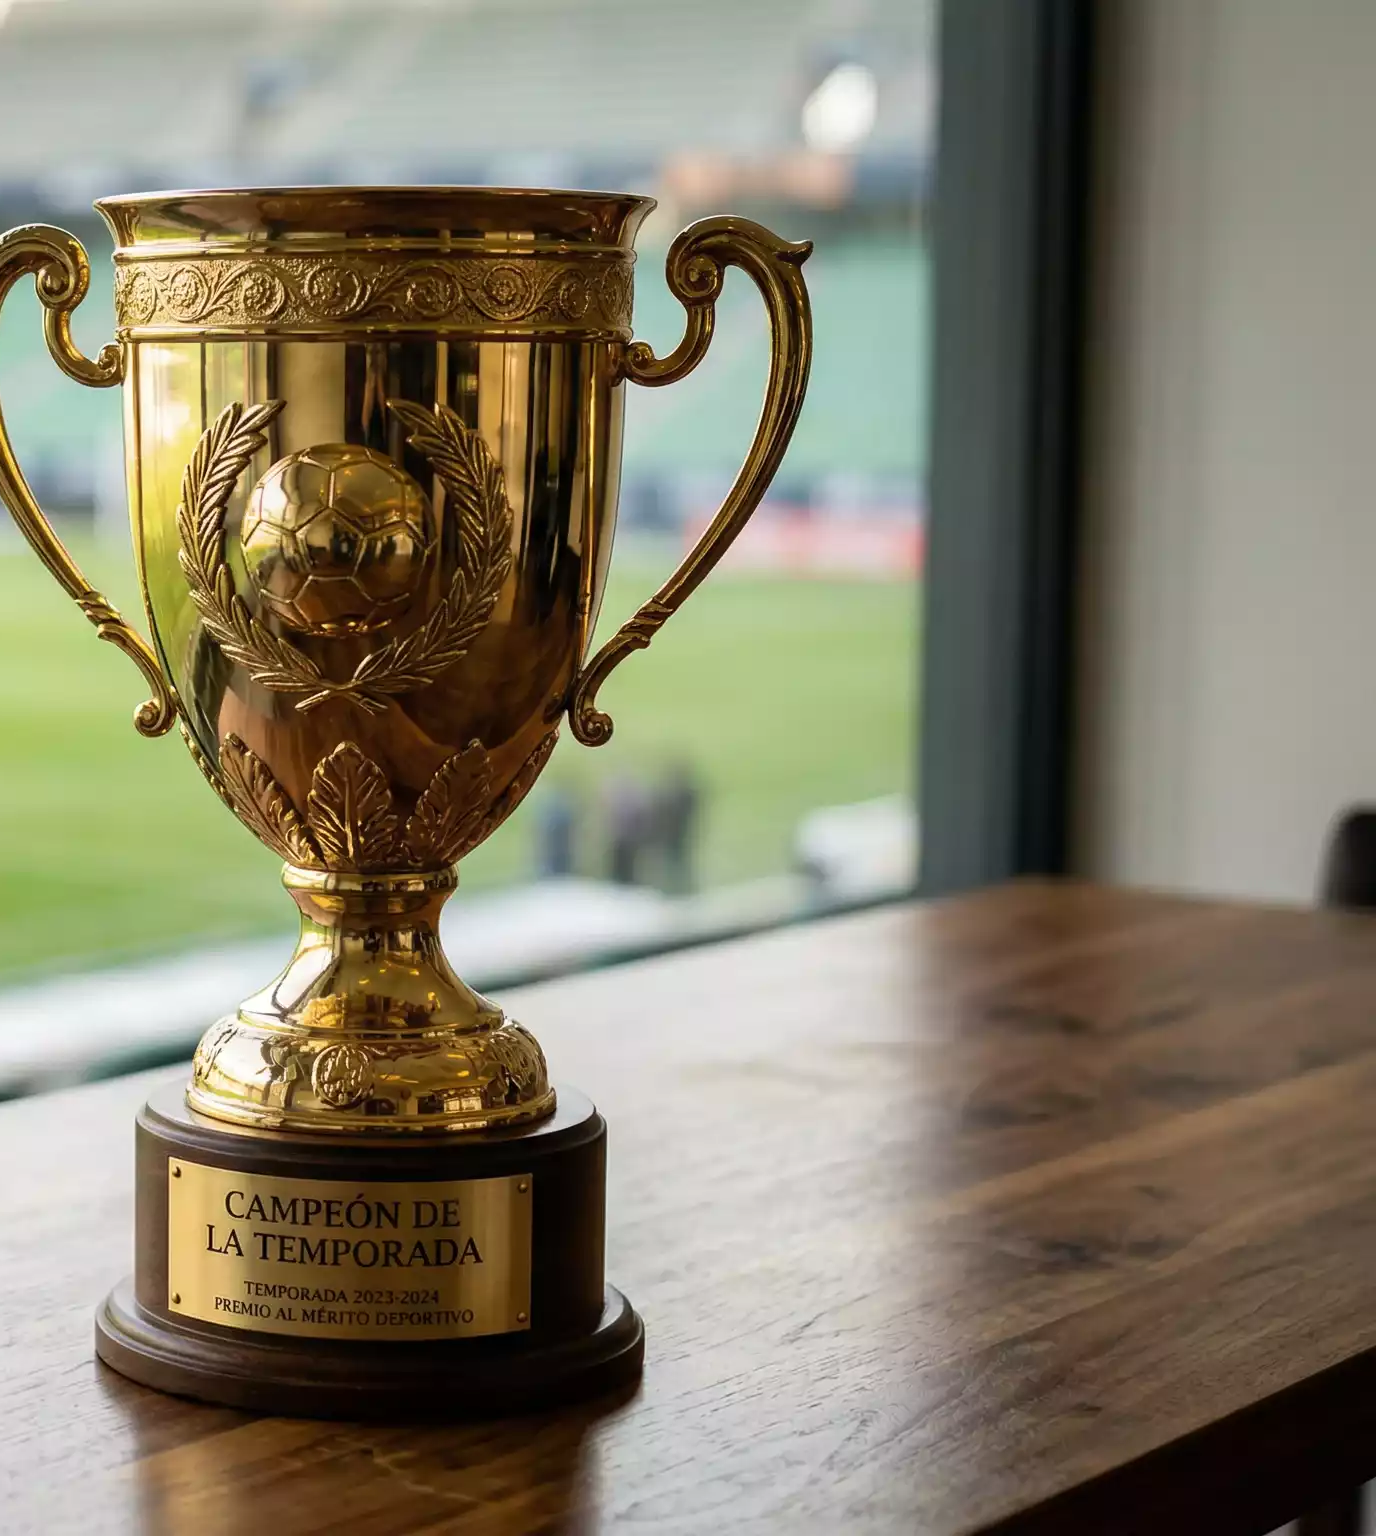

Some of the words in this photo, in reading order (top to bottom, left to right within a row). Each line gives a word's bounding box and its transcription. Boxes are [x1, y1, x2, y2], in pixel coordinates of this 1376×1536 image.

[224, 1190, 400, 1229] CAMPEÓN
[412, 1199, 461, 1228] DE
[206, 1224, 244, 1257] LA
[253, 1231, 483, 1268] TEMPORADA
[244, 1281, 348, 1304] TEMPORADA
[353, 1289, 440, 1305] 2023-2024
[214, 1296, 272, 1319] PREMIO
[276, 1308, 298, 1322] AL
[302, 1308, 370, 1326] MÉRITO
[375, 1310, 474, 1327] DEPORTIVO
